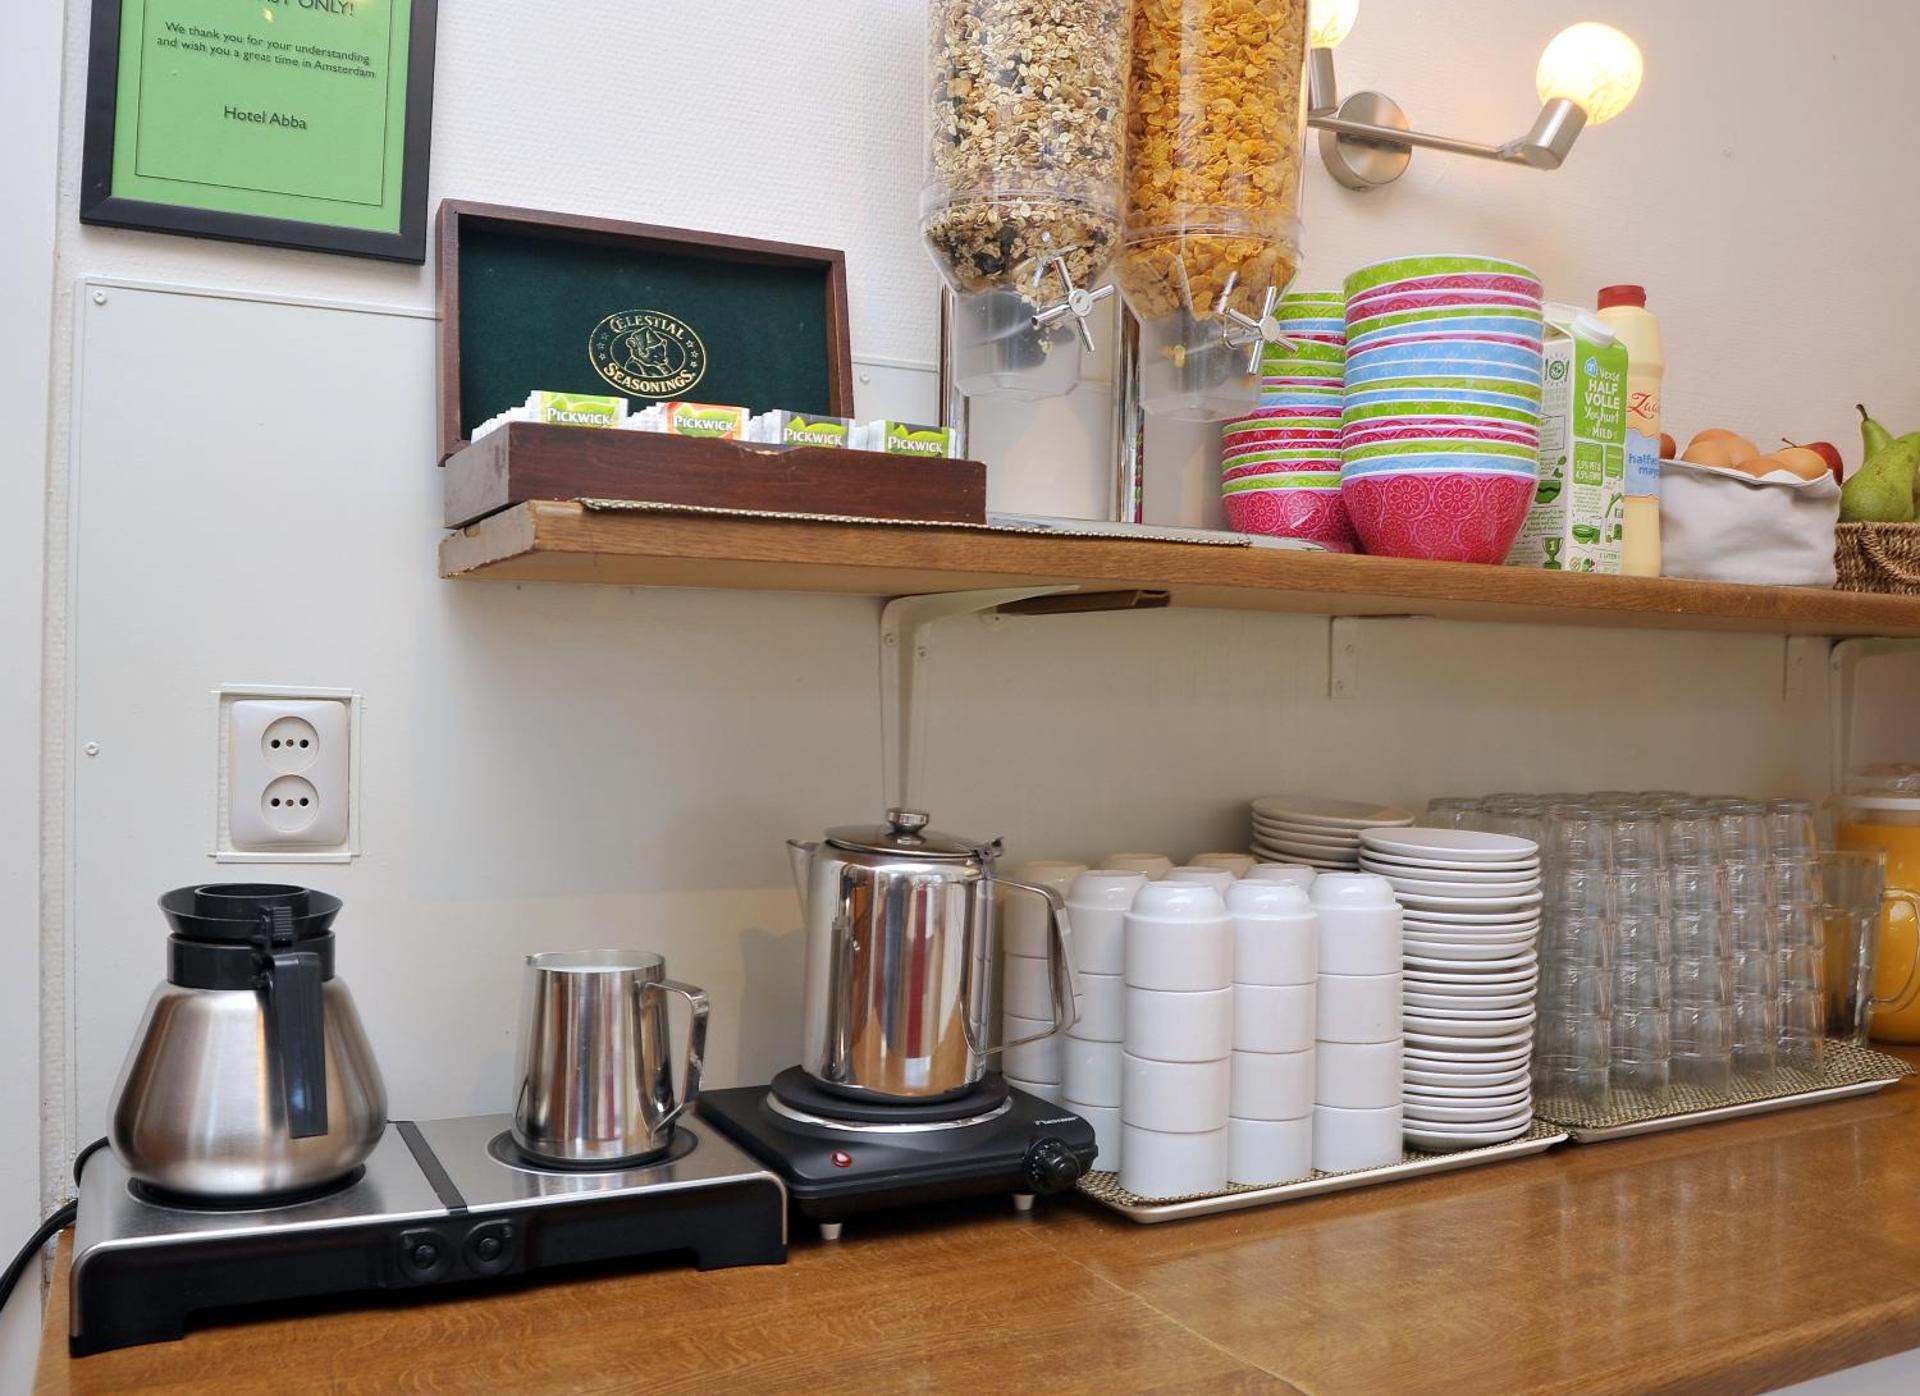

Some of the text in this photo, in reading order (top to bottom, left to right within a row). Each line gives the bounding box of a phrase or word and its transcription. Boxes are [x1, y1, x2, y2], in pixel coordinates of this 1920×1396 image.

[157, 37, 178, 48] and
[181, 41, 206, 52] wish
[209, 46, 230, 57] you
[233, 49, 239, 57] a
[243, 51, 271, 62] great
[275, 55, 299, 66] time
[302, 59, 312, 68] in
[165, 21, 370, 66] We thank you for your understanding
[224, 105, 307, 130] Hotel Abba
[609, 315, 686, 340] CELESTIAL
[603, 362, 693, 393] SEASONINGS
[1589, 379, 1619, 396] HALF
[1584, 391, 1620, 410] VOLLE
